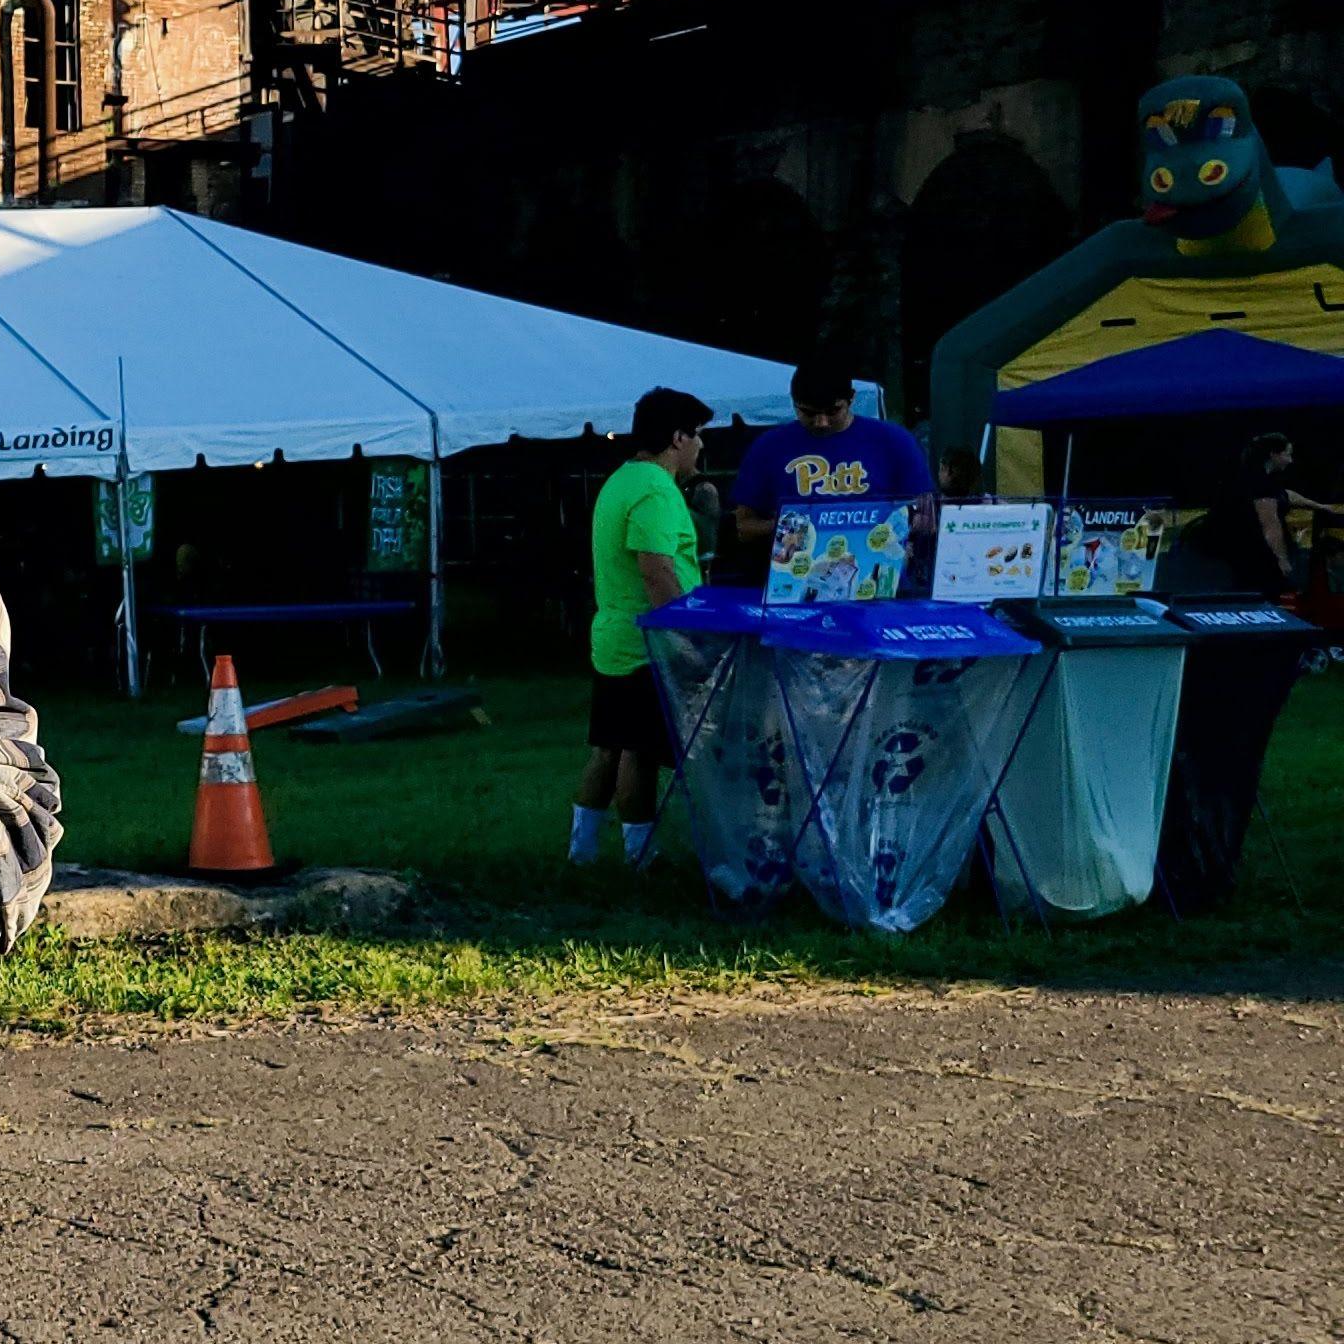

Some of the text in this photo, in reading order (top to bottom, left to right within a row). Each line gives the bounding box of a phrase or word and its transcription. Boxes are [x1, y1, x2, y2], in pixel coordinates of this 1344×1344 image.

[785, 454, 870, 496] Pitt
[818, 509, 880, 525] RECYCLE
[1085, 510, 1137, 526] LANDFILL
